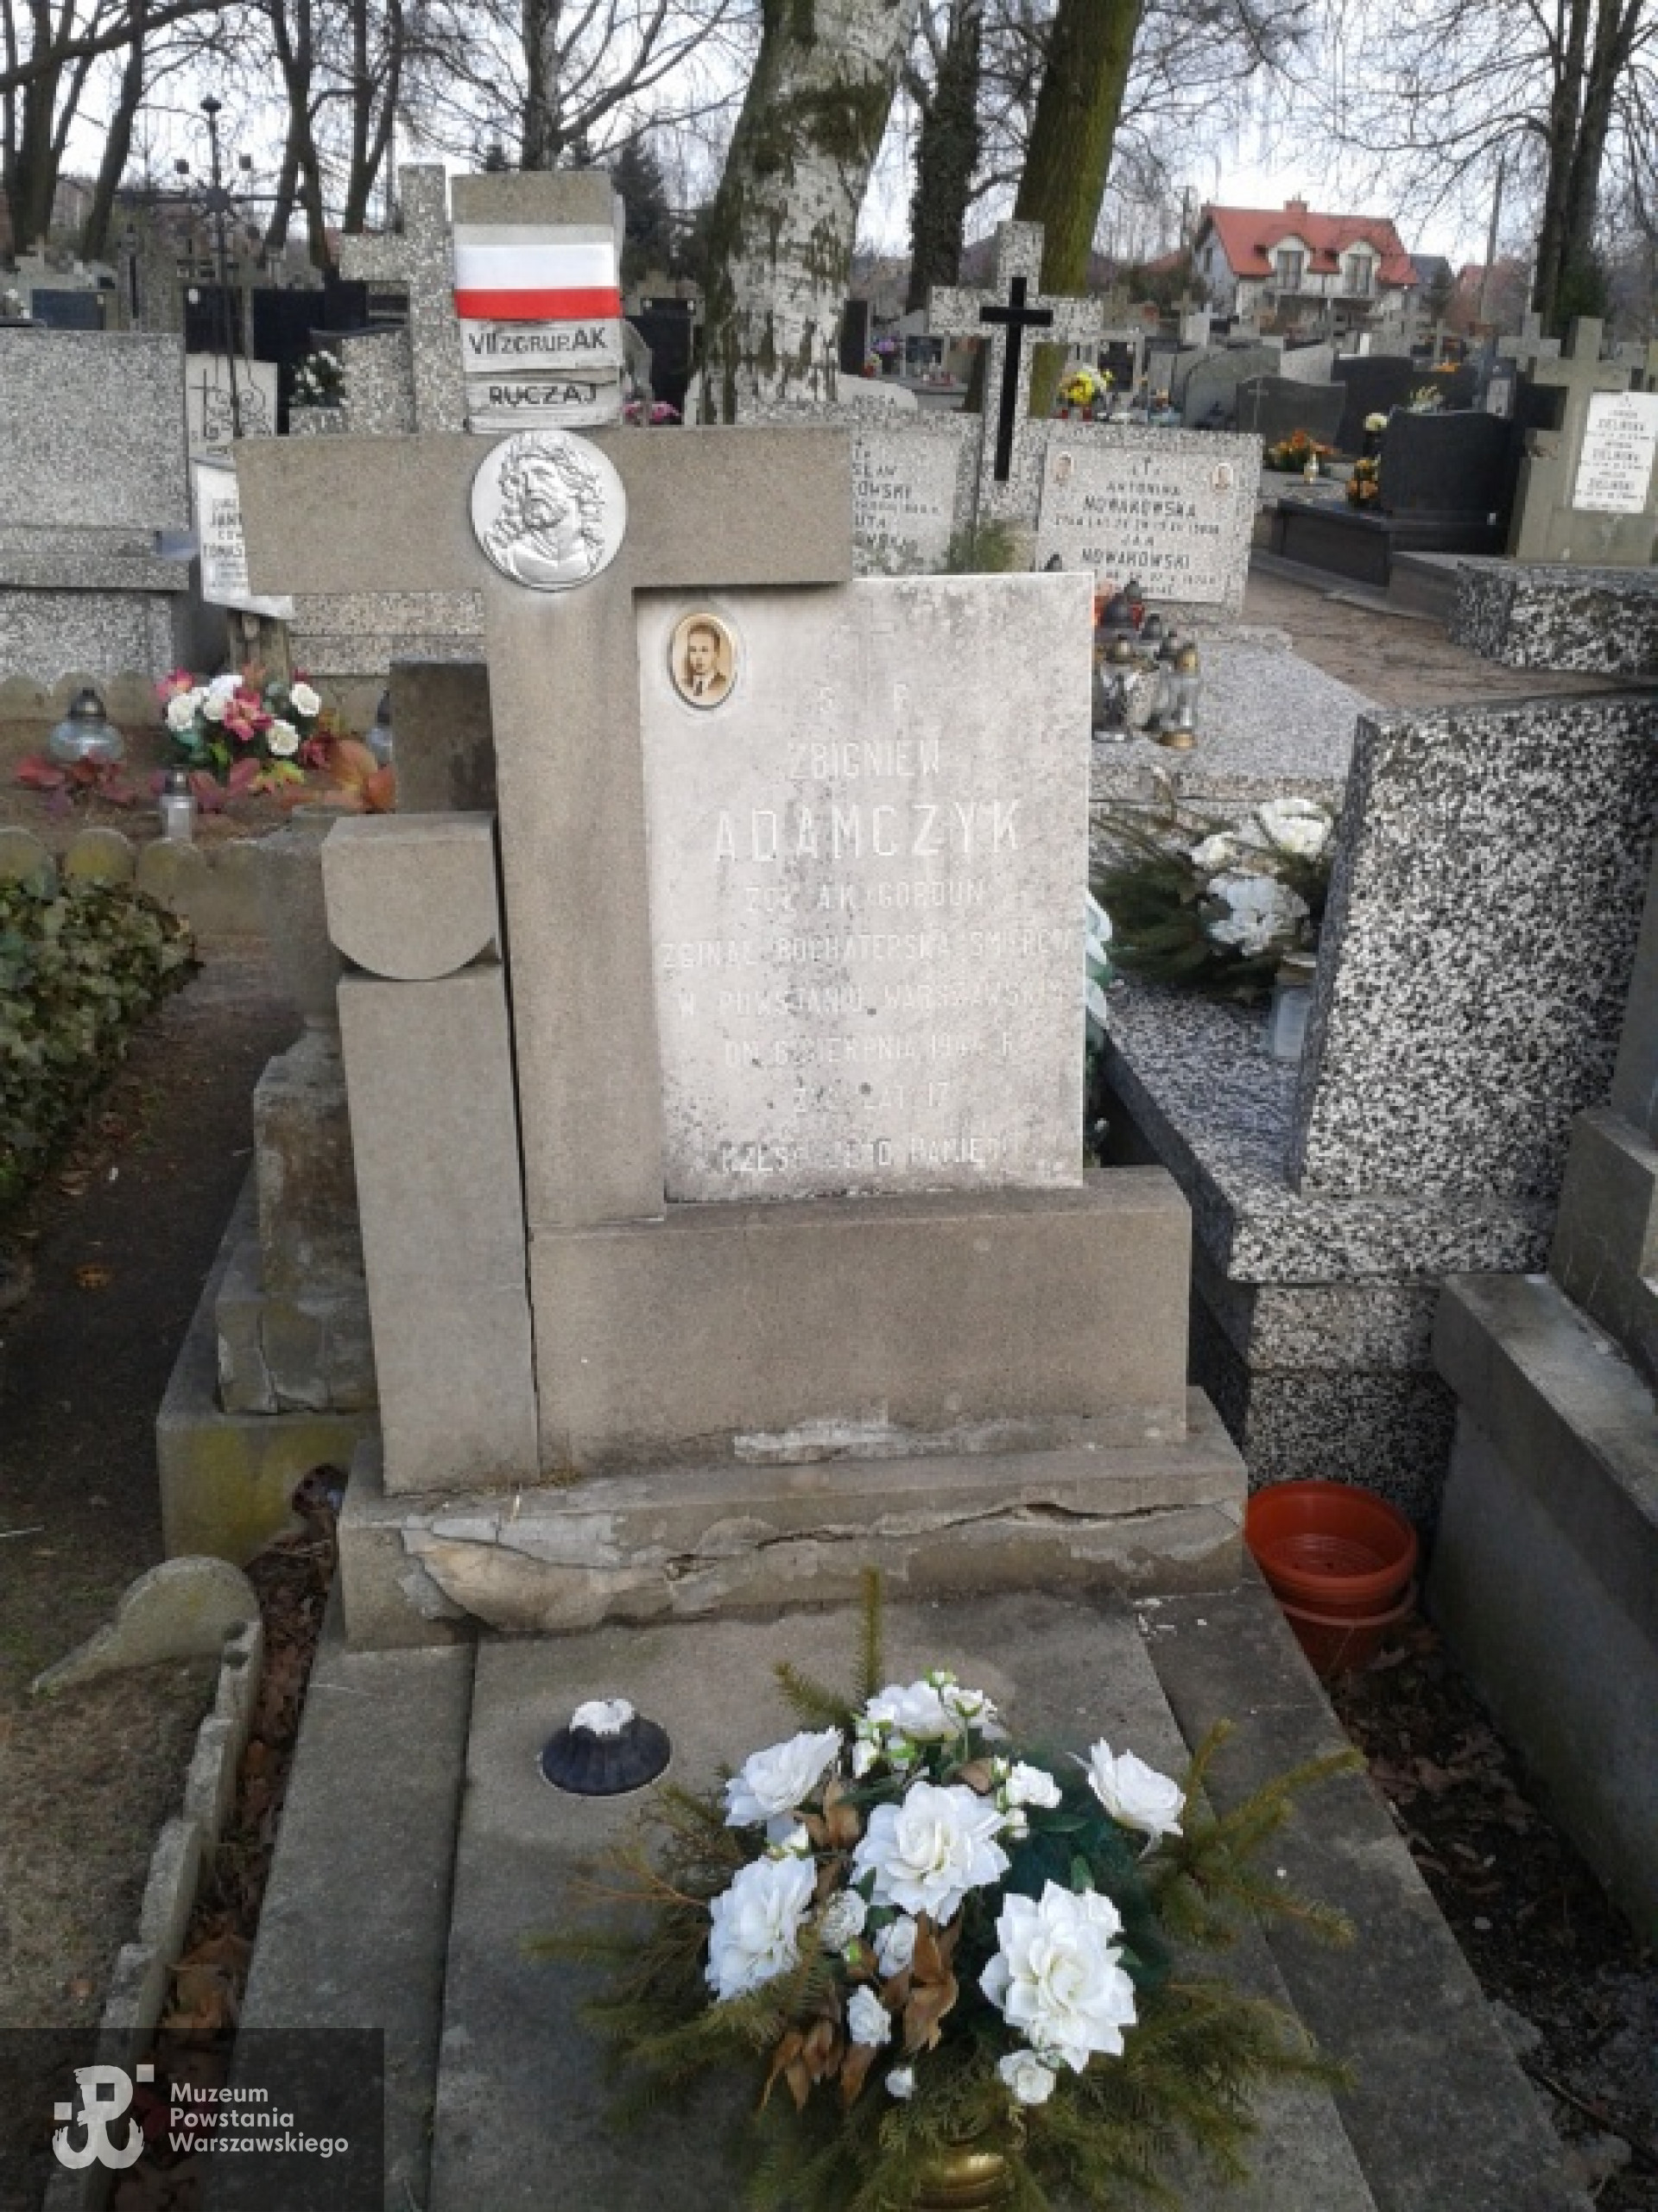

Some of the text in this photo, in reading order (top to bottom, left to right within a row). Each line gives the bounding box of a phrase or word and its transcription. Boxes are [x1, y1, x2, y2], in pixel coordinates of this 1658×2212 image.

[489, 384, 598, 407] RUCZAJ
[787, 738, 940, 780] ZBIGNIEW
[715, 799, 1022, 863] ADAMCZYK
